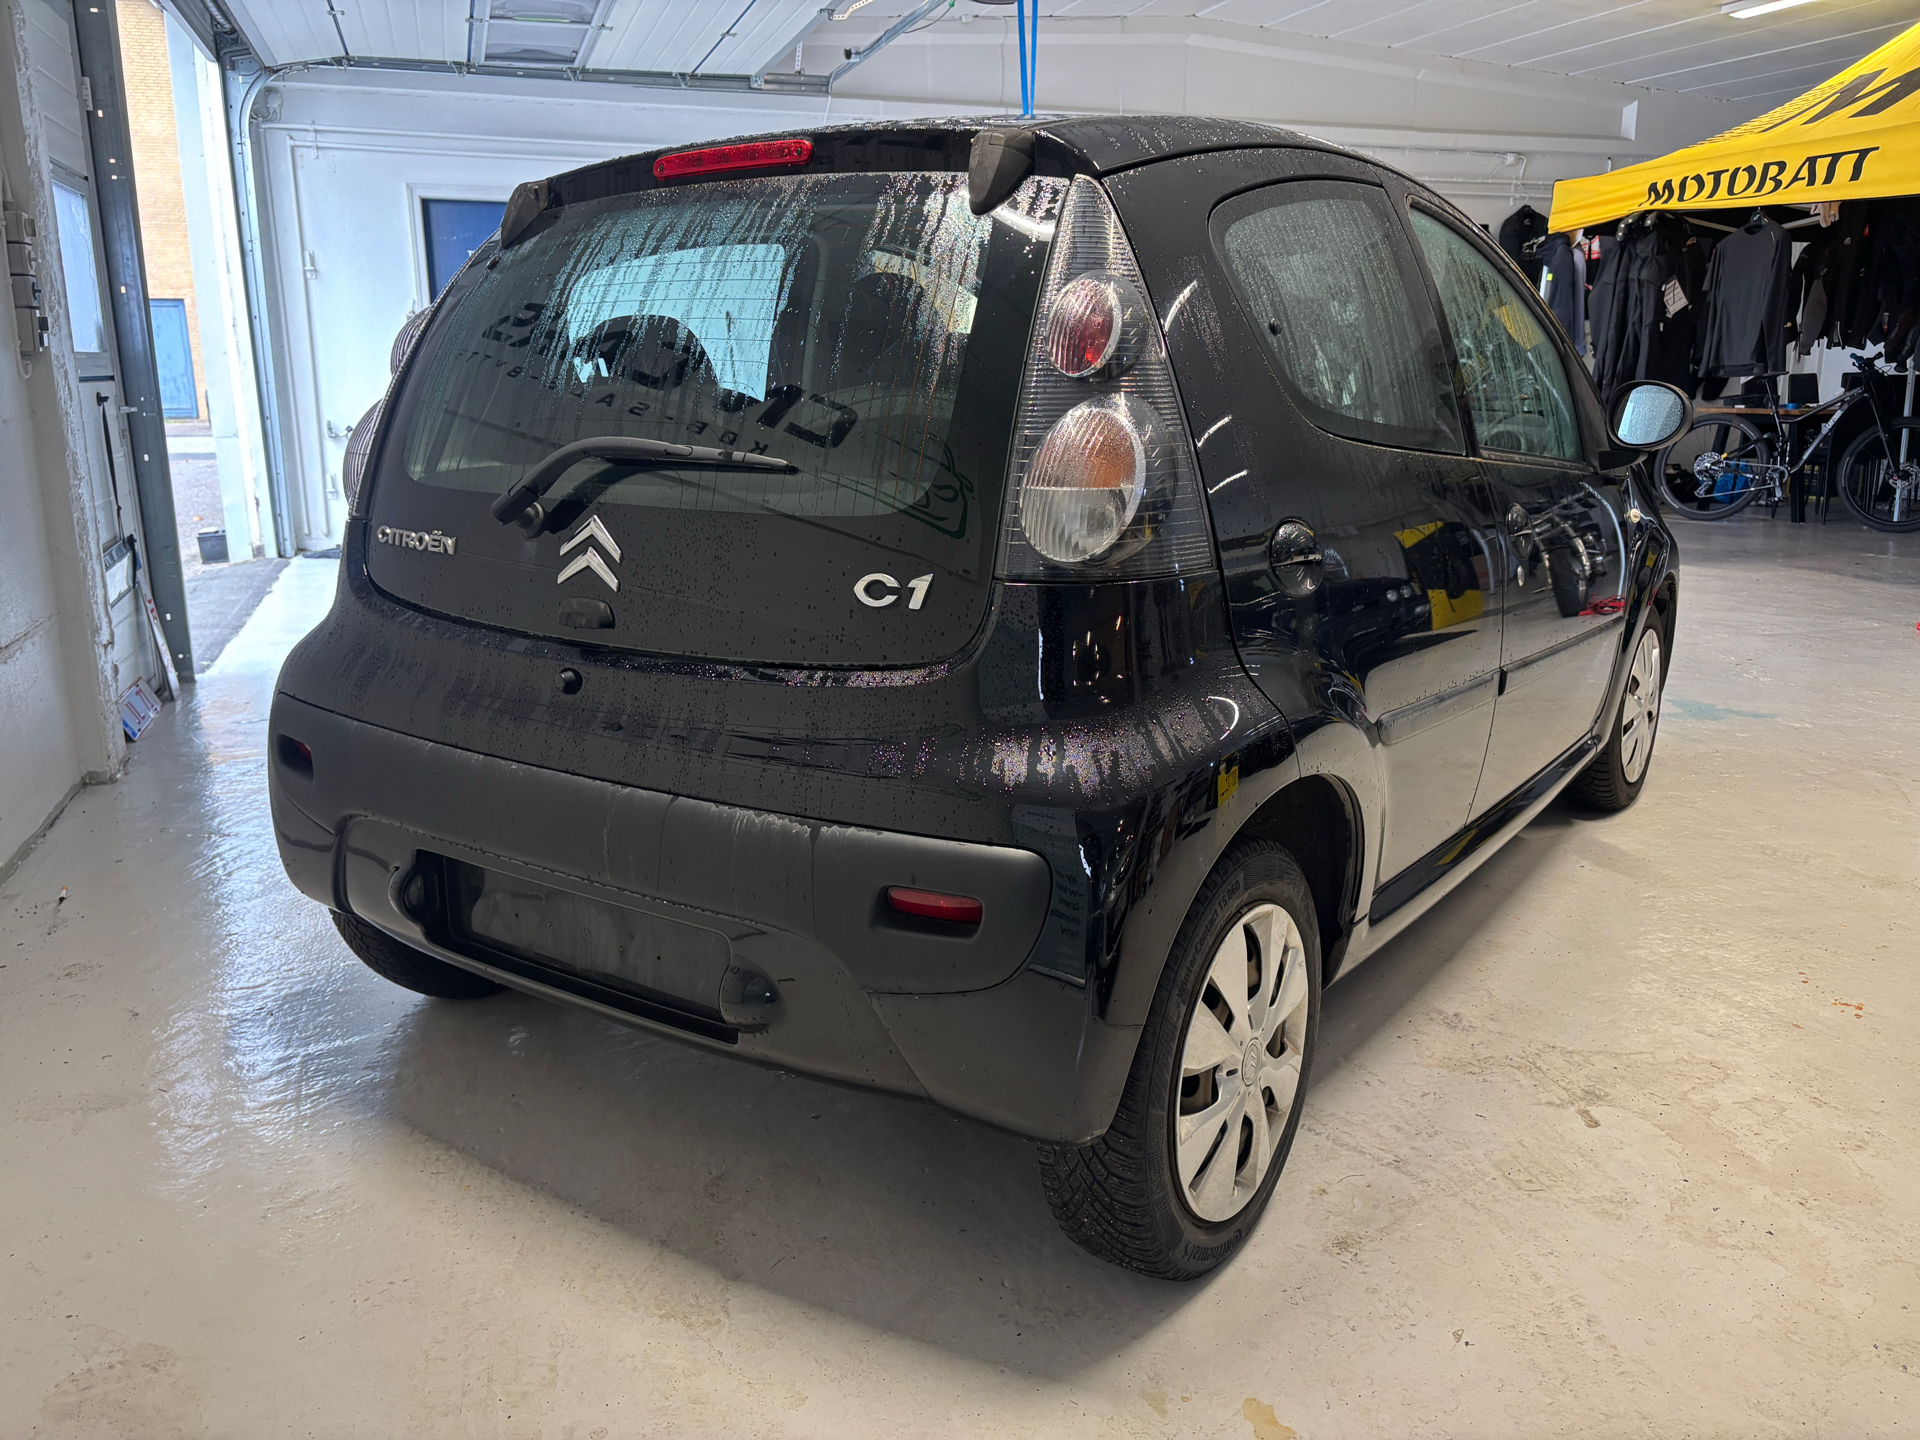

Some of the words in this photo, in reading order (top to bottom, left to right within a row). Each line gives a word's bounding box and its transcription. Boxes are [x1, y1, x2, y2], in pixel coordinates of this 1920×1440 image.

[1638, 146, 1880, 207] MOTOBATT
[377, 525, 457, 555] CITROËN
[853, 572, 934, 610] C1
[1226, 879, 1242, 900] 860
[1187, 1228, 1242, 1263] Continental
